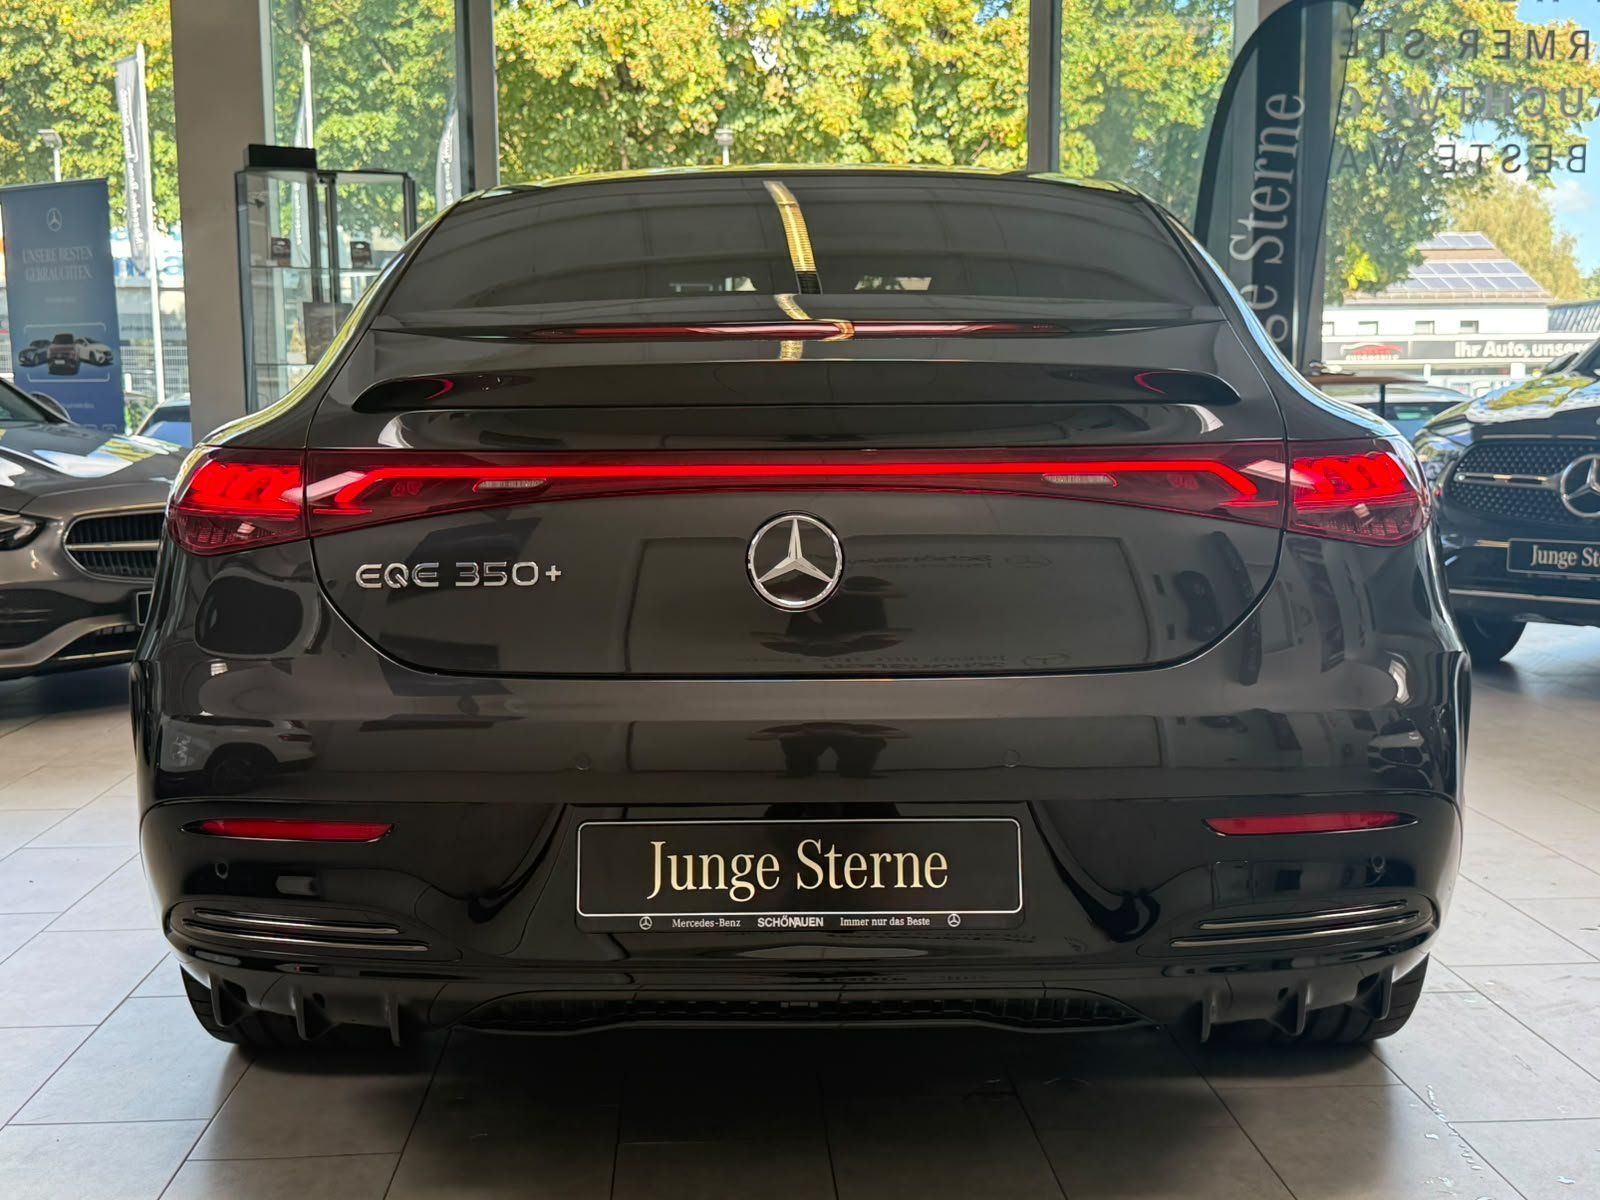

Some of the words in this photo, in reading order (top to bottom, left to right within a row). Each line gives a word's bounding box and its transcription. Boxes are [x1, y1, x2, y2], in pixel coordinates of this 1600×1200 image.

[1229, 93, 1305, 265] Sterne
[1454, 341, 1481, 357] Ihr
[1482, 341, 1531, 358] Auto,
[1530, 544, 1578, 569] Junge
[1581, 546, 1600, 567] St
[355, 562, 439, 589] EQE
[455, 561, 562, 587] 350+
[647, 840, 780, 902] Junge
[796, 838, 948, 890] Sterne
[671, 918, 741, 928] Mercedes-Benz
[840, 917, 869, 926] Immer
[871, 918, 888, 926] nur
[889, 916, 905, 926] das
[906, 916, 931, 926] Beste
